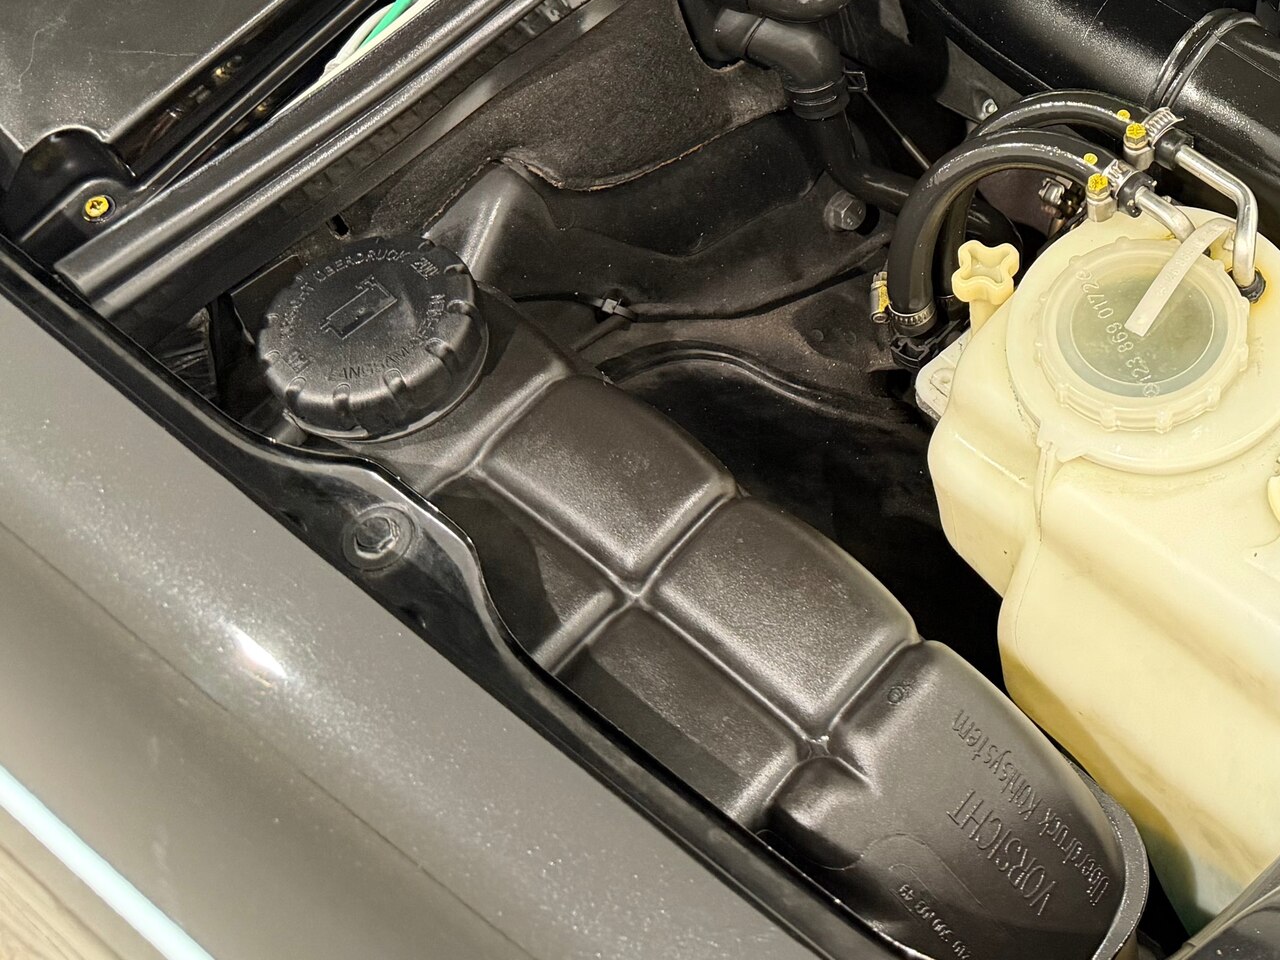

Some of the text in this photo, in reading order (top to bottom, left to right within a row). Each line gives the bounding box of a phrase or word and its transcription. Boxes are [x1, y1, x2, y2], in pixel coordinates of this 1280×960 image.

[1105, 321, 1134, 353] 869
[946, 790, 1056, 916] VORSICHT
[952, 709, 1109, 906] Überdruck Kühlsystem
